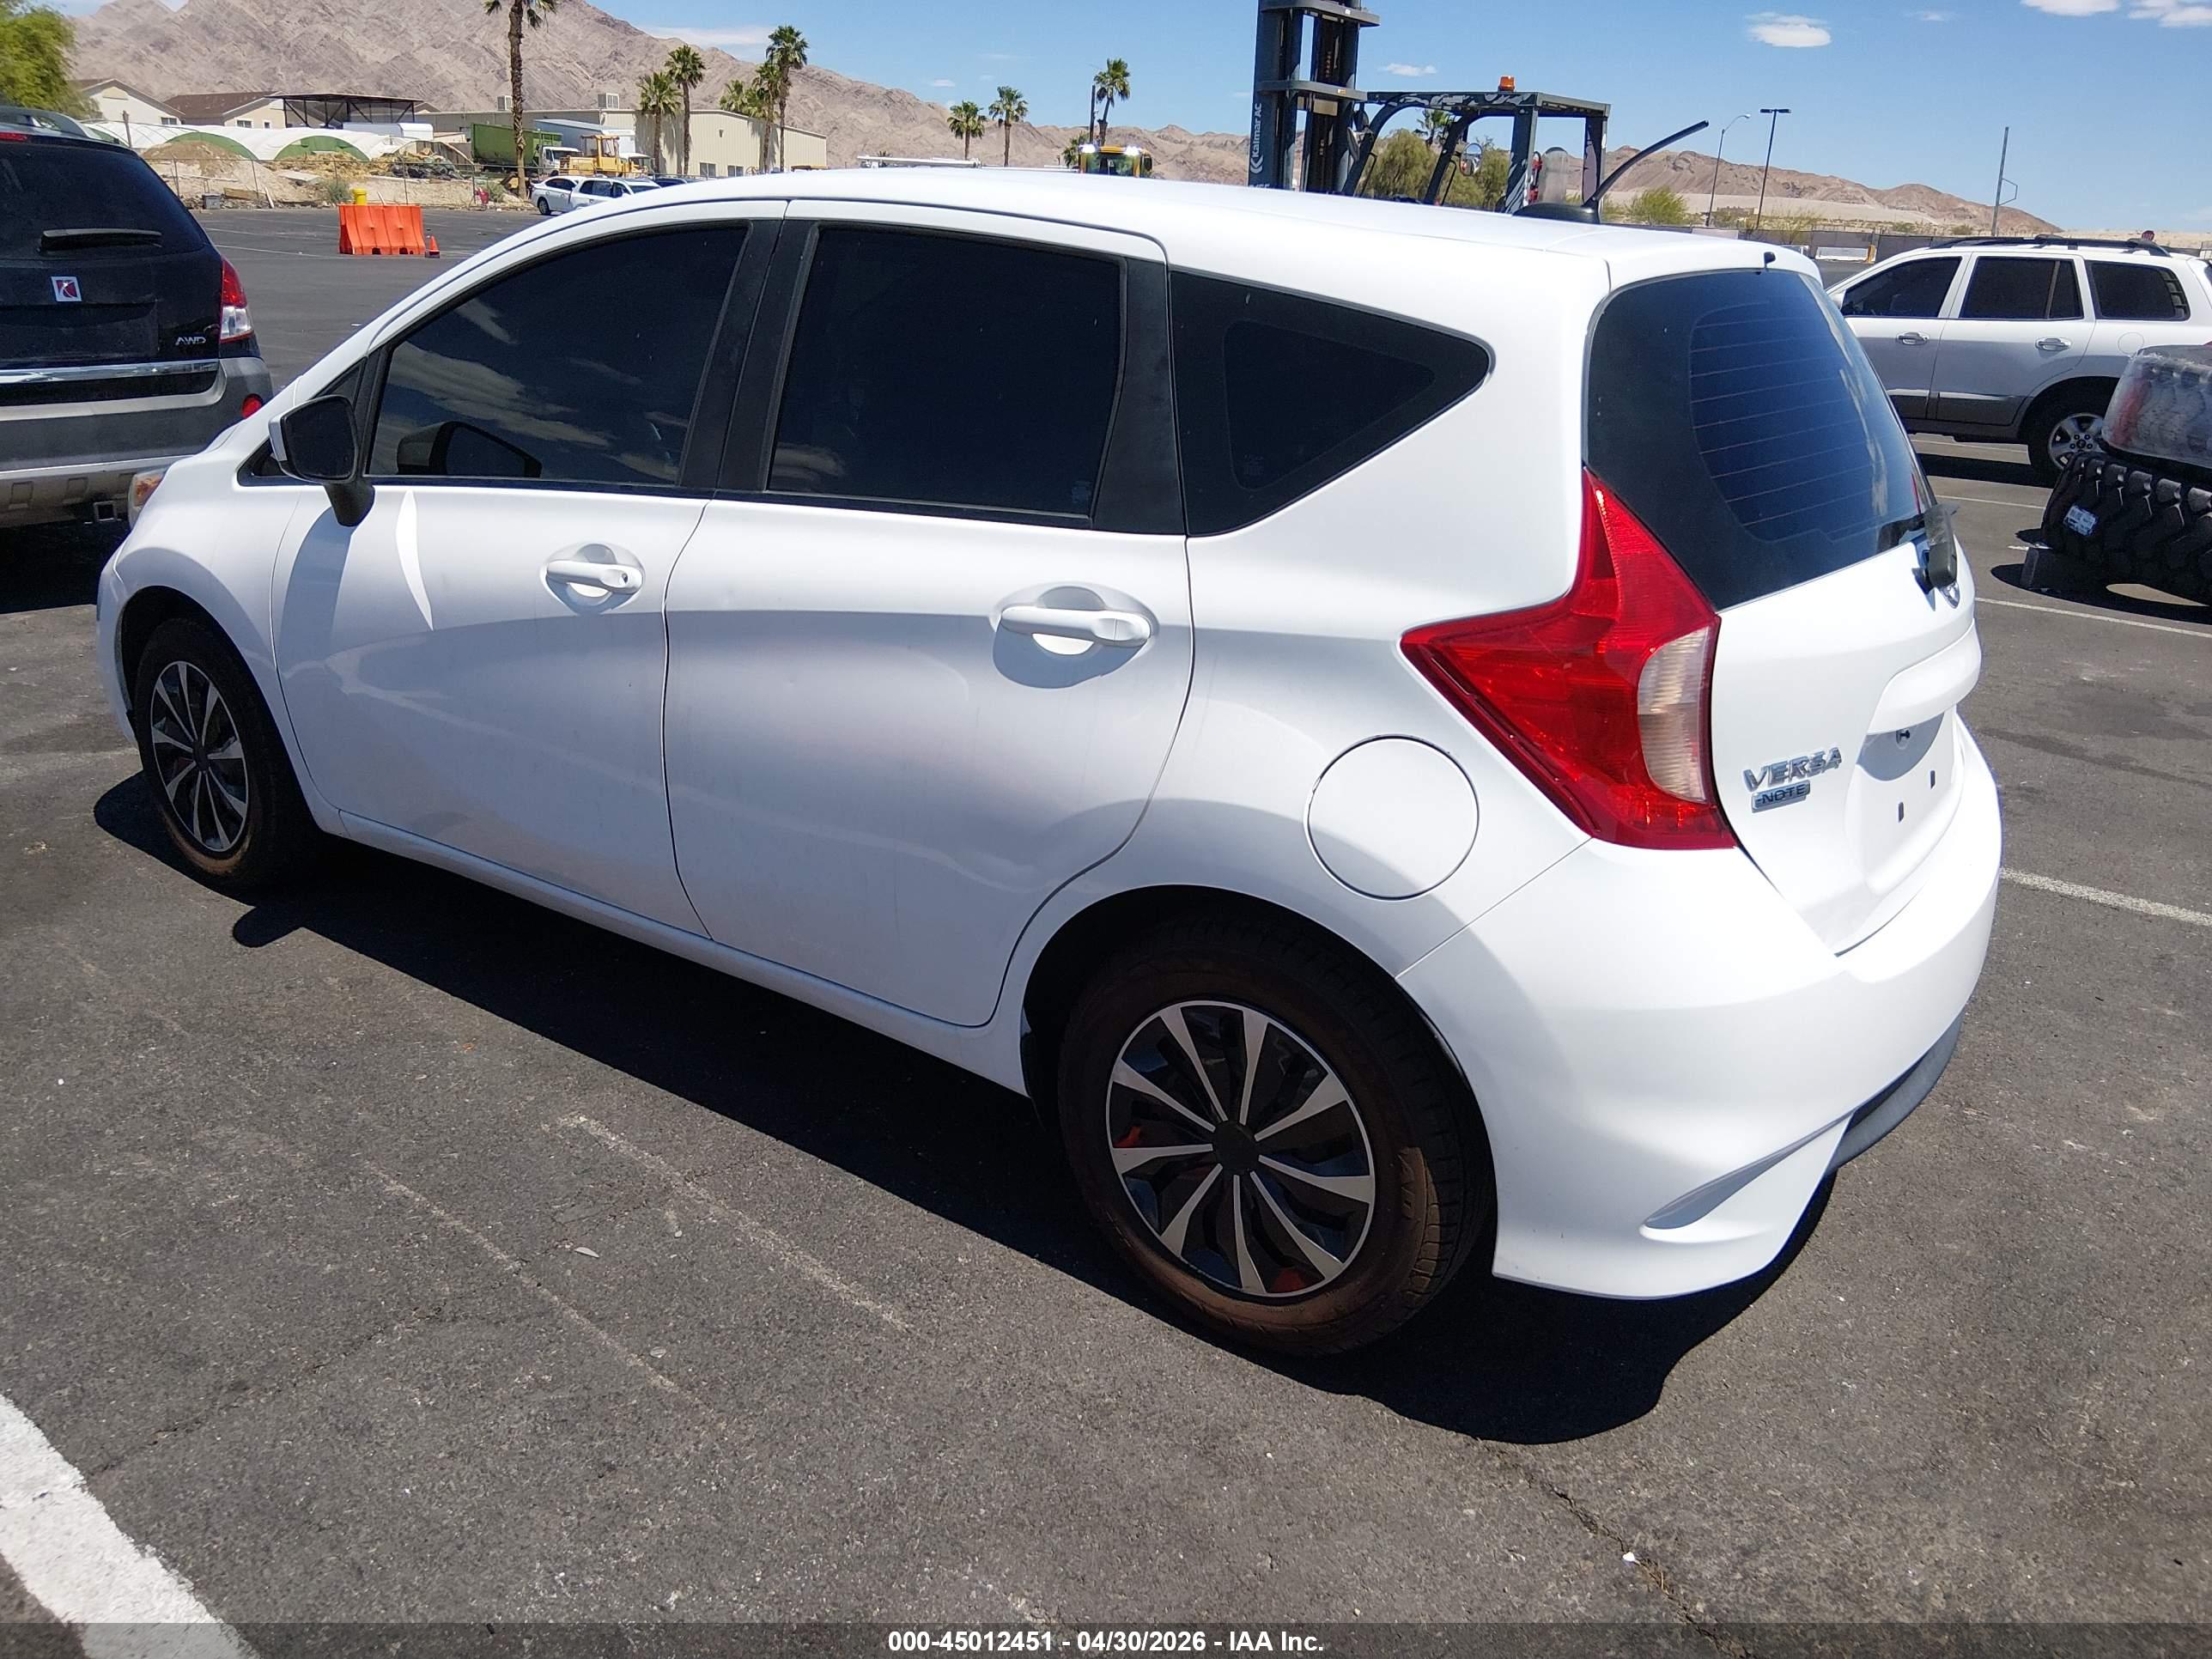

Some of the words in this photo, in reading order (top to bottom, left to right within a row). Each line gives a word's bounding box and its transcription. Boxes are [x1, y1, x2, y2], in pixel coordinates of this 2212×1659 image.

[1255, 103, 1262, 118] AC
[1252, 118, 1261, 157] Kalmar
[175, 336, 207, 346] AWD
[1743, 747, 1842, 793] VERSA
[1760, 784, 1807, 804] NOTE
